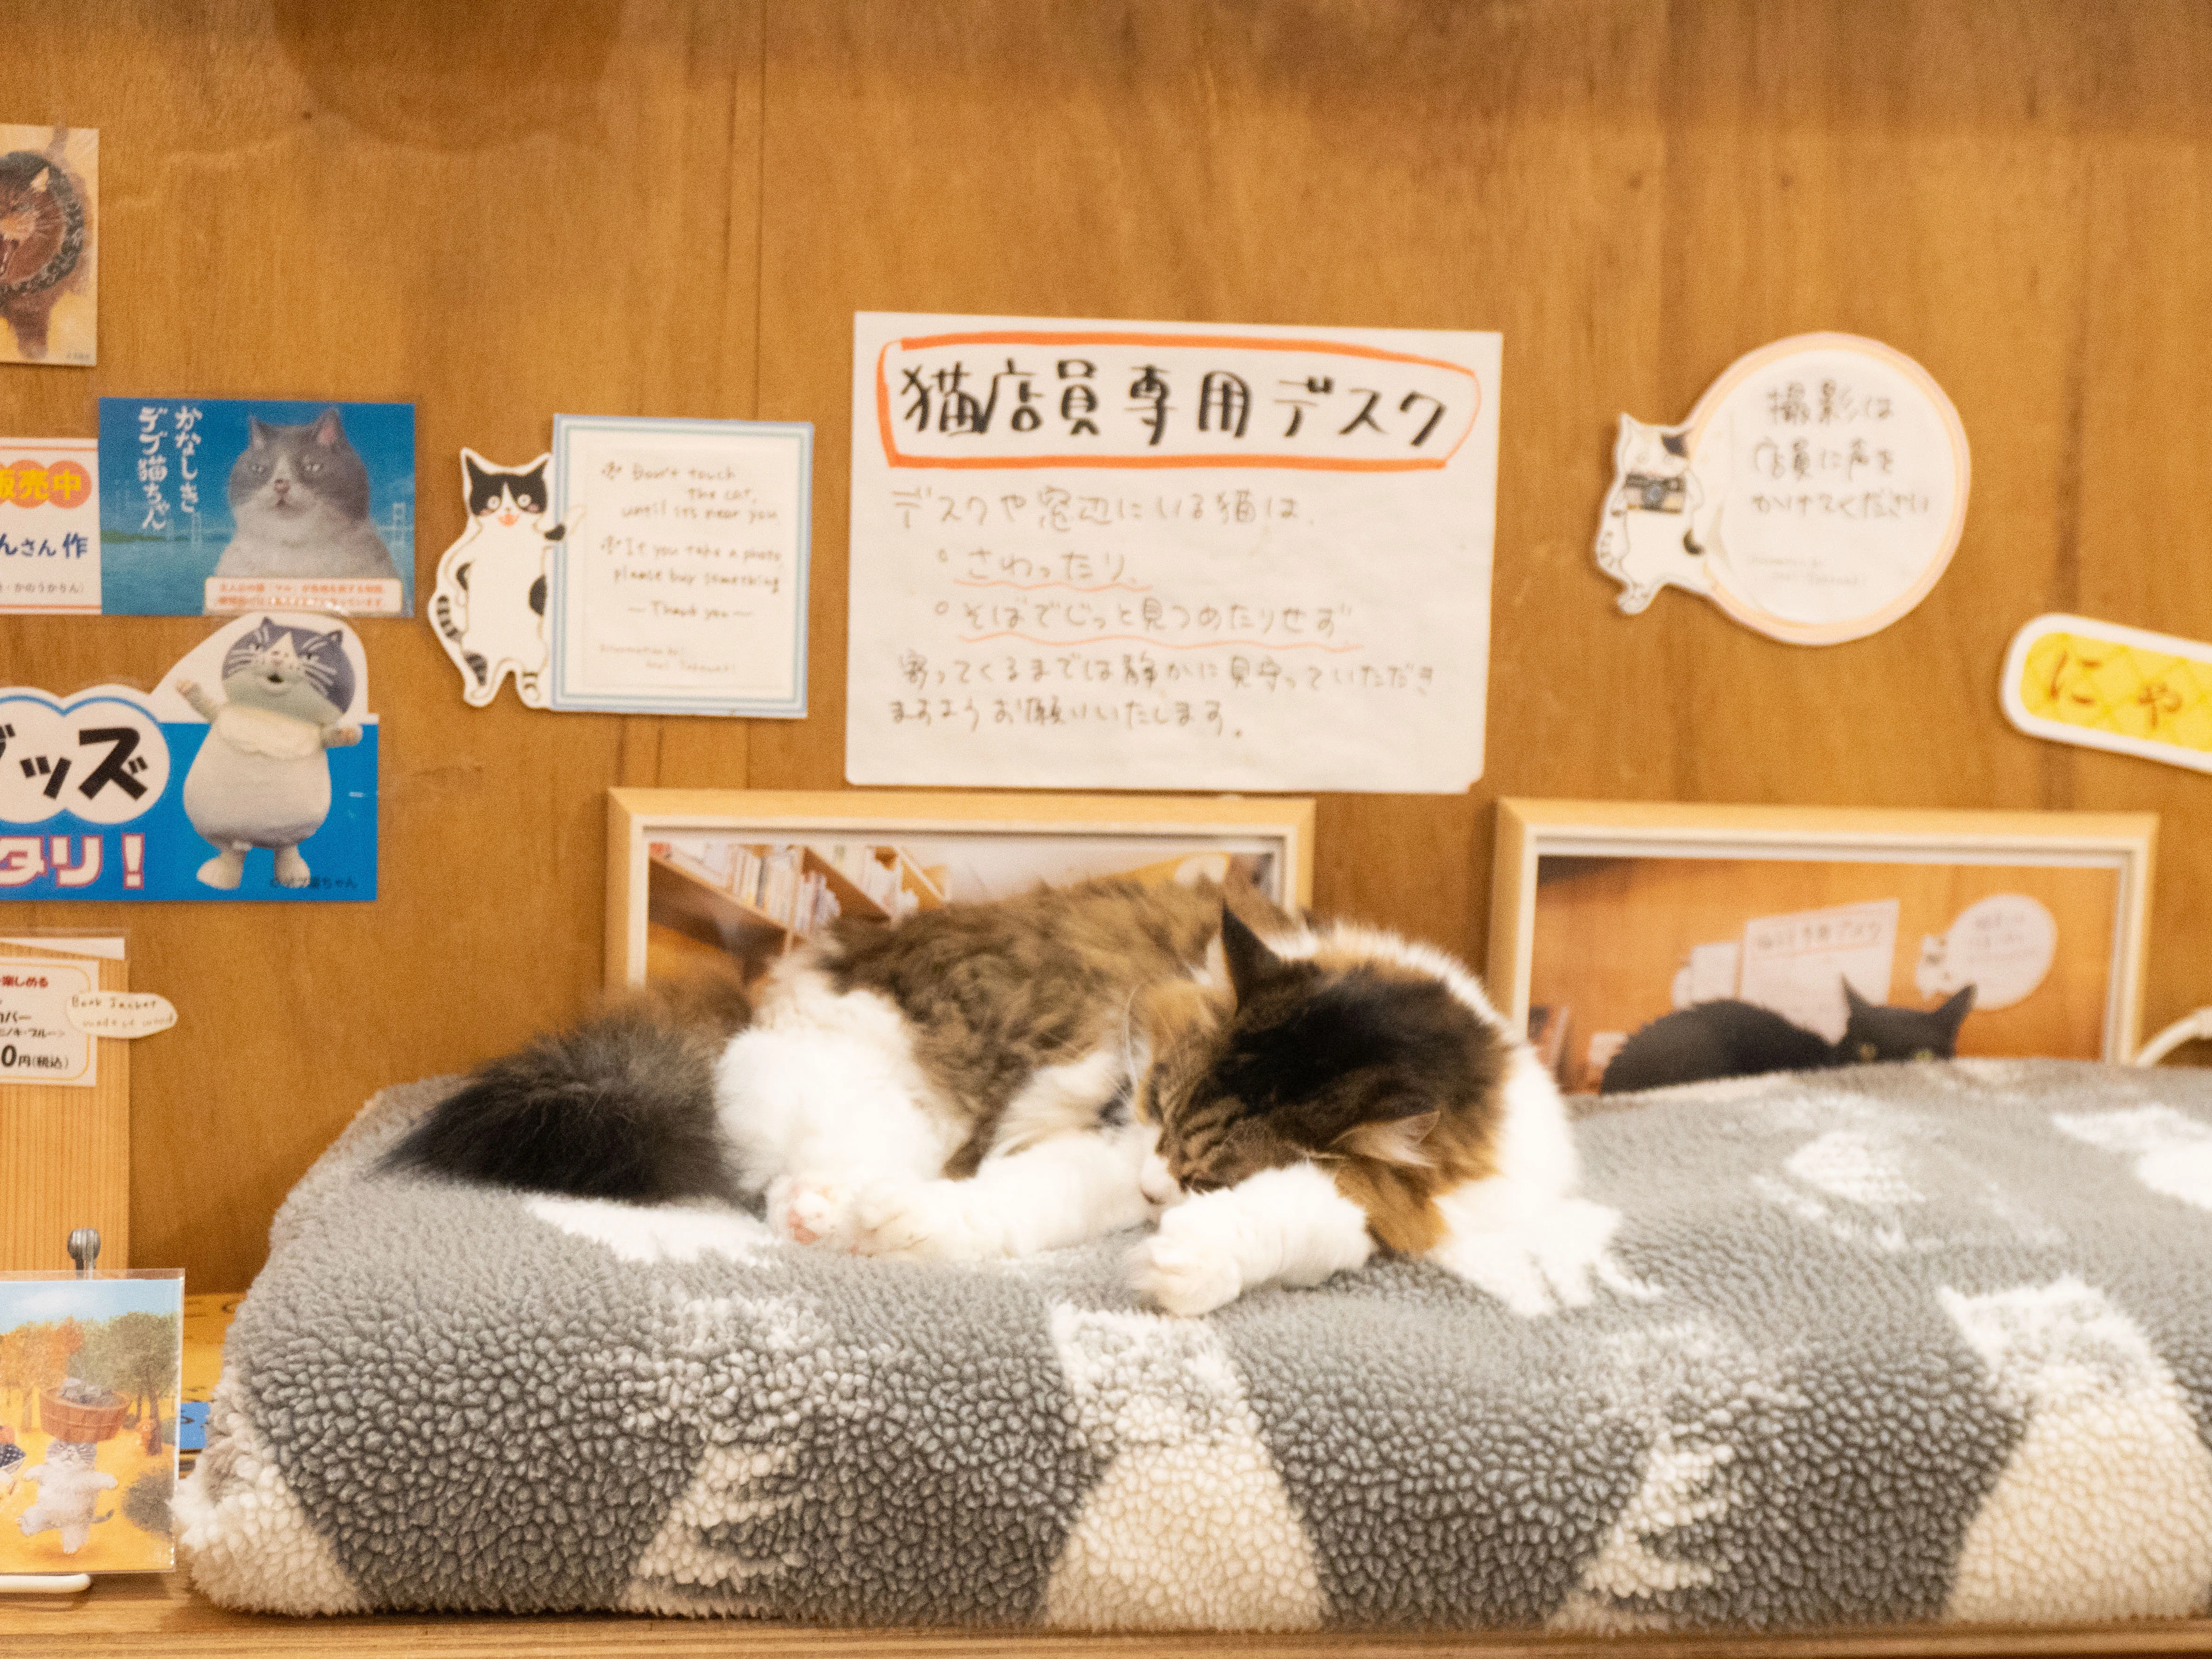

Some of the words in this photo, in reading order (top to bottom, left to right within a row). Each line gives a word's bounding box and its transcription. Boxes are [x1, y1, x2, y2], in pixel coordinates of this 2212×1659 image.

[900, 357, 1447, 447] 猫店員専用デスク
[138, 407, 171, 530] デブ猫ちゃん
[175, 406, 203, 513] かなしき
[688, 466, 736, 480] touch
[653, 545, 678, 560] you
[669, 569, 696, 585] buy
[0, 723, 148, 801] ッズ
[0, 1011, 31, 1023] バー
